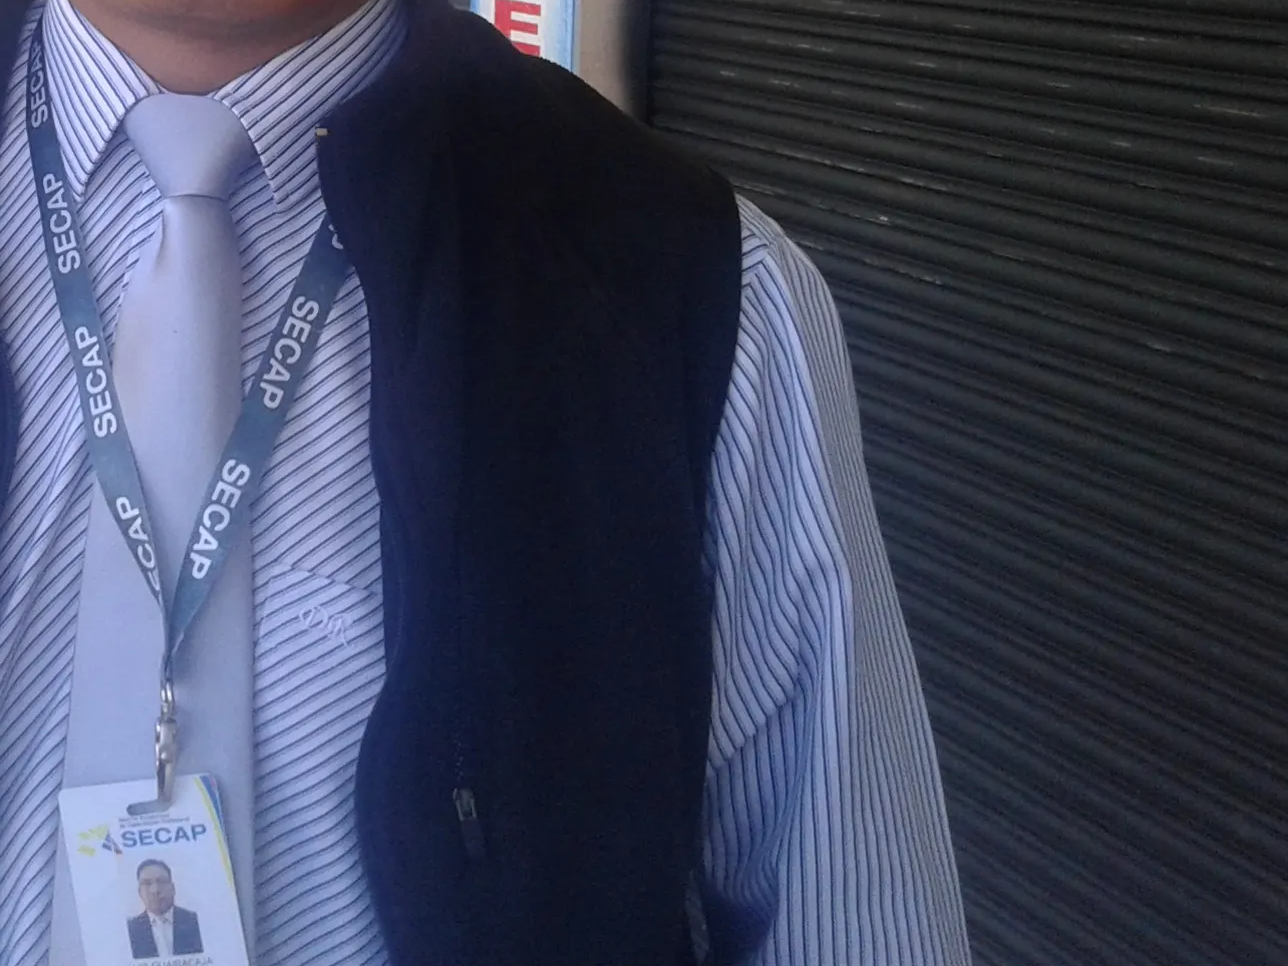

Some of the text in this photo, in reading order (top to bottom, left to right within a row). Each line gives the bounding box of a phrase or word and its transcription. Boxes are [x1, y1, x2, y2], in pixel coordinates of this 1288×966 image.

[30, 40, 49, 129] SECAP
[43, 173, 81, 274] SECAP
[74, 325, 118, 439] SECAP
[259, 295, 320, 410] SECAP
[190, 458, 251, 580] SECAP
[121, 823, 207, 848] SECAP
